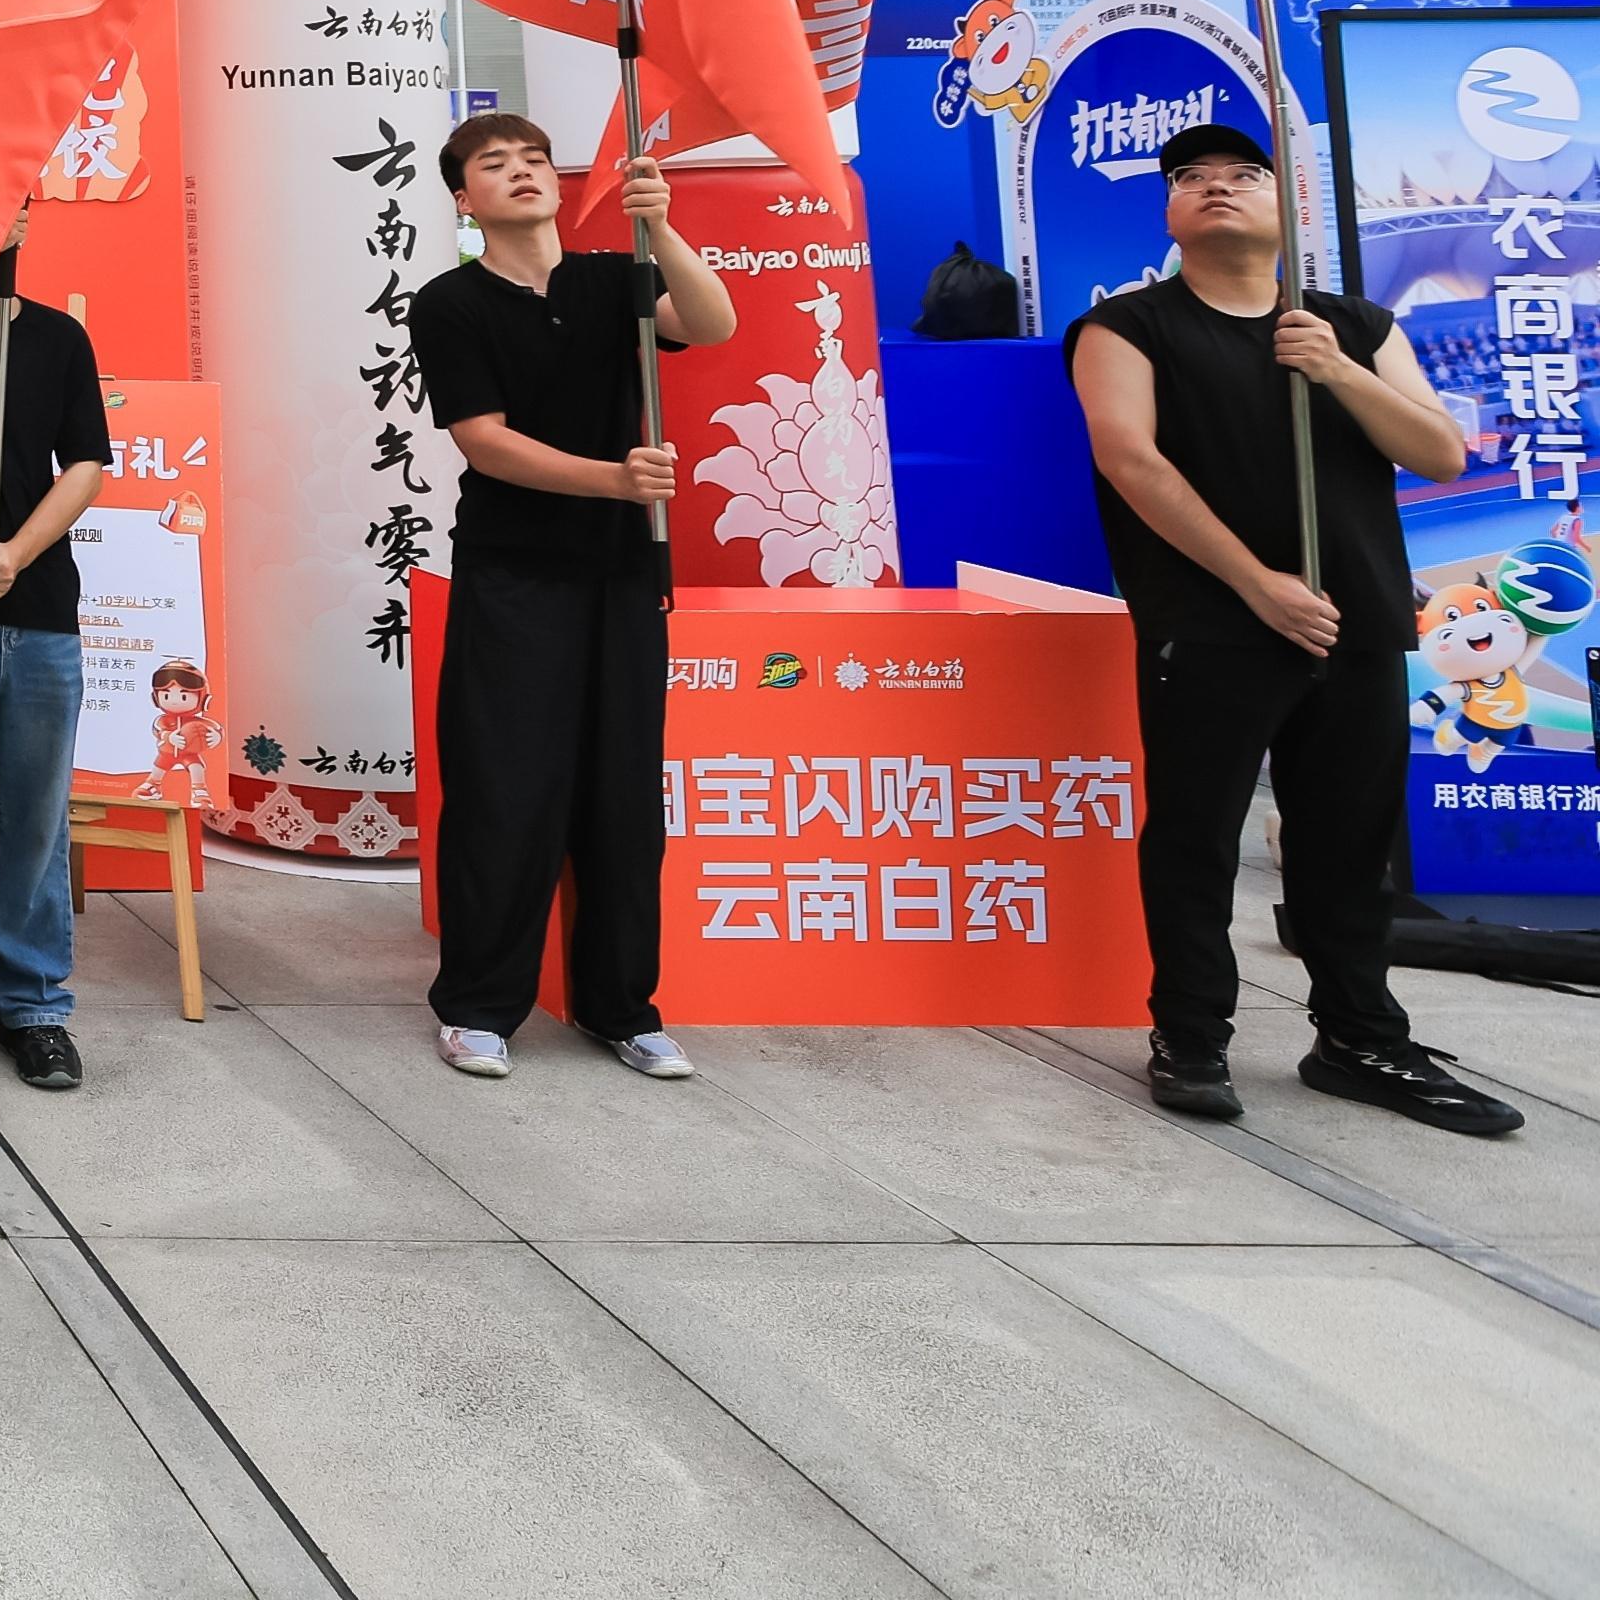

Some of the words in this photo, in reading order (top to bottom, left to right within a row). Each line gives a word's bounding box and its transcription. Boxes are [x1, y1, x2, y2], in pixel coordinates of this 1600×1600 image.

[305, 6, 434, 40] 云南白药
[906, 37, 953, 50] 220cm
[221, 62, 340, 92] Yunnan
[346, 59, 431, 92] Baiyao
[766, 195, 838, 217] 云南白
[701, 247, 798, 277] Baiyao
[803, 242, 863, 272] Qiwuji
[1488, 194, 1587, 501] 农商银行
[874, 657, 965, 679] 云南白药
[697, 858, 1048, 944] 云南白药
